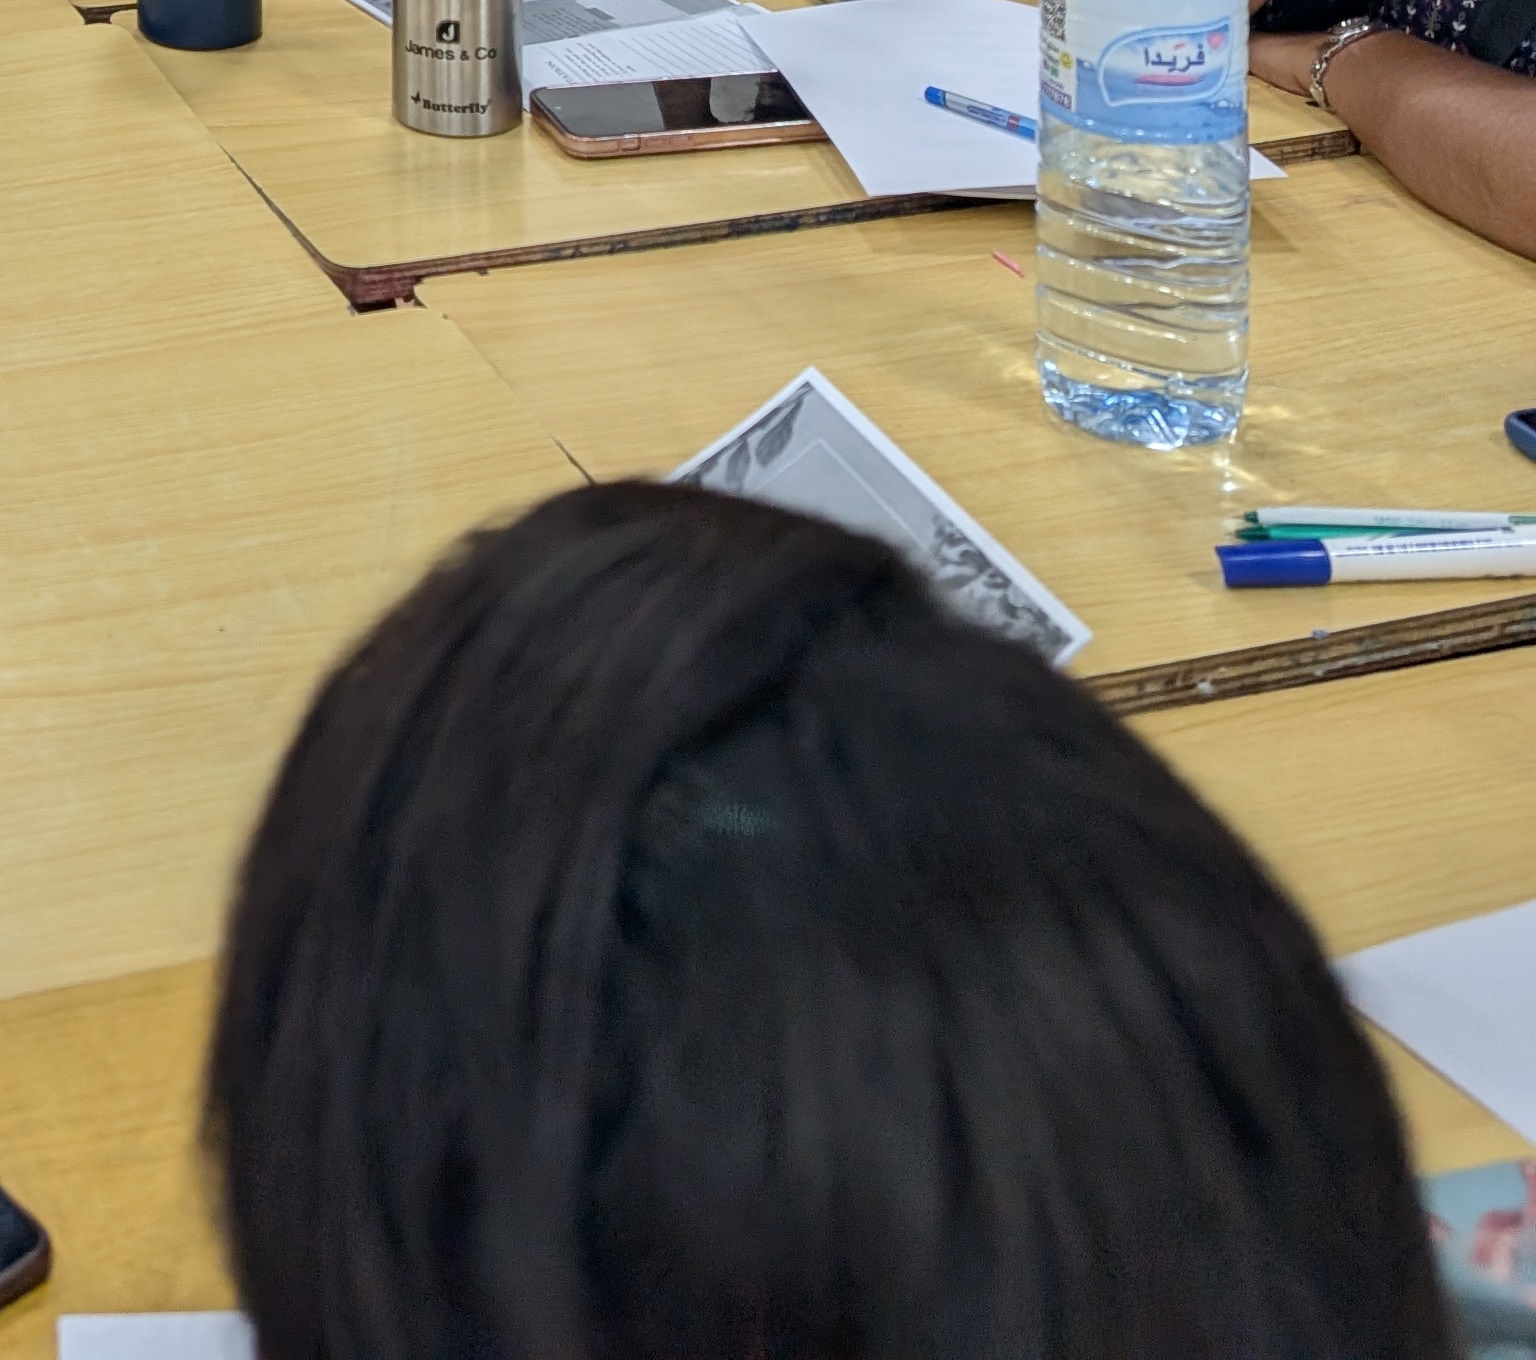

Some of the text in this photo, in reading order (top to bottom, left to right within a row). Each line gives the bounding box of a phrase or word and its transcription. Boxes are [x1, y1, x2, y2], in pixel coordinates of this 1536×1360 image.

[404, 39, 498, 61] James & Co
[422, 98, 490, 115] Butterfly
